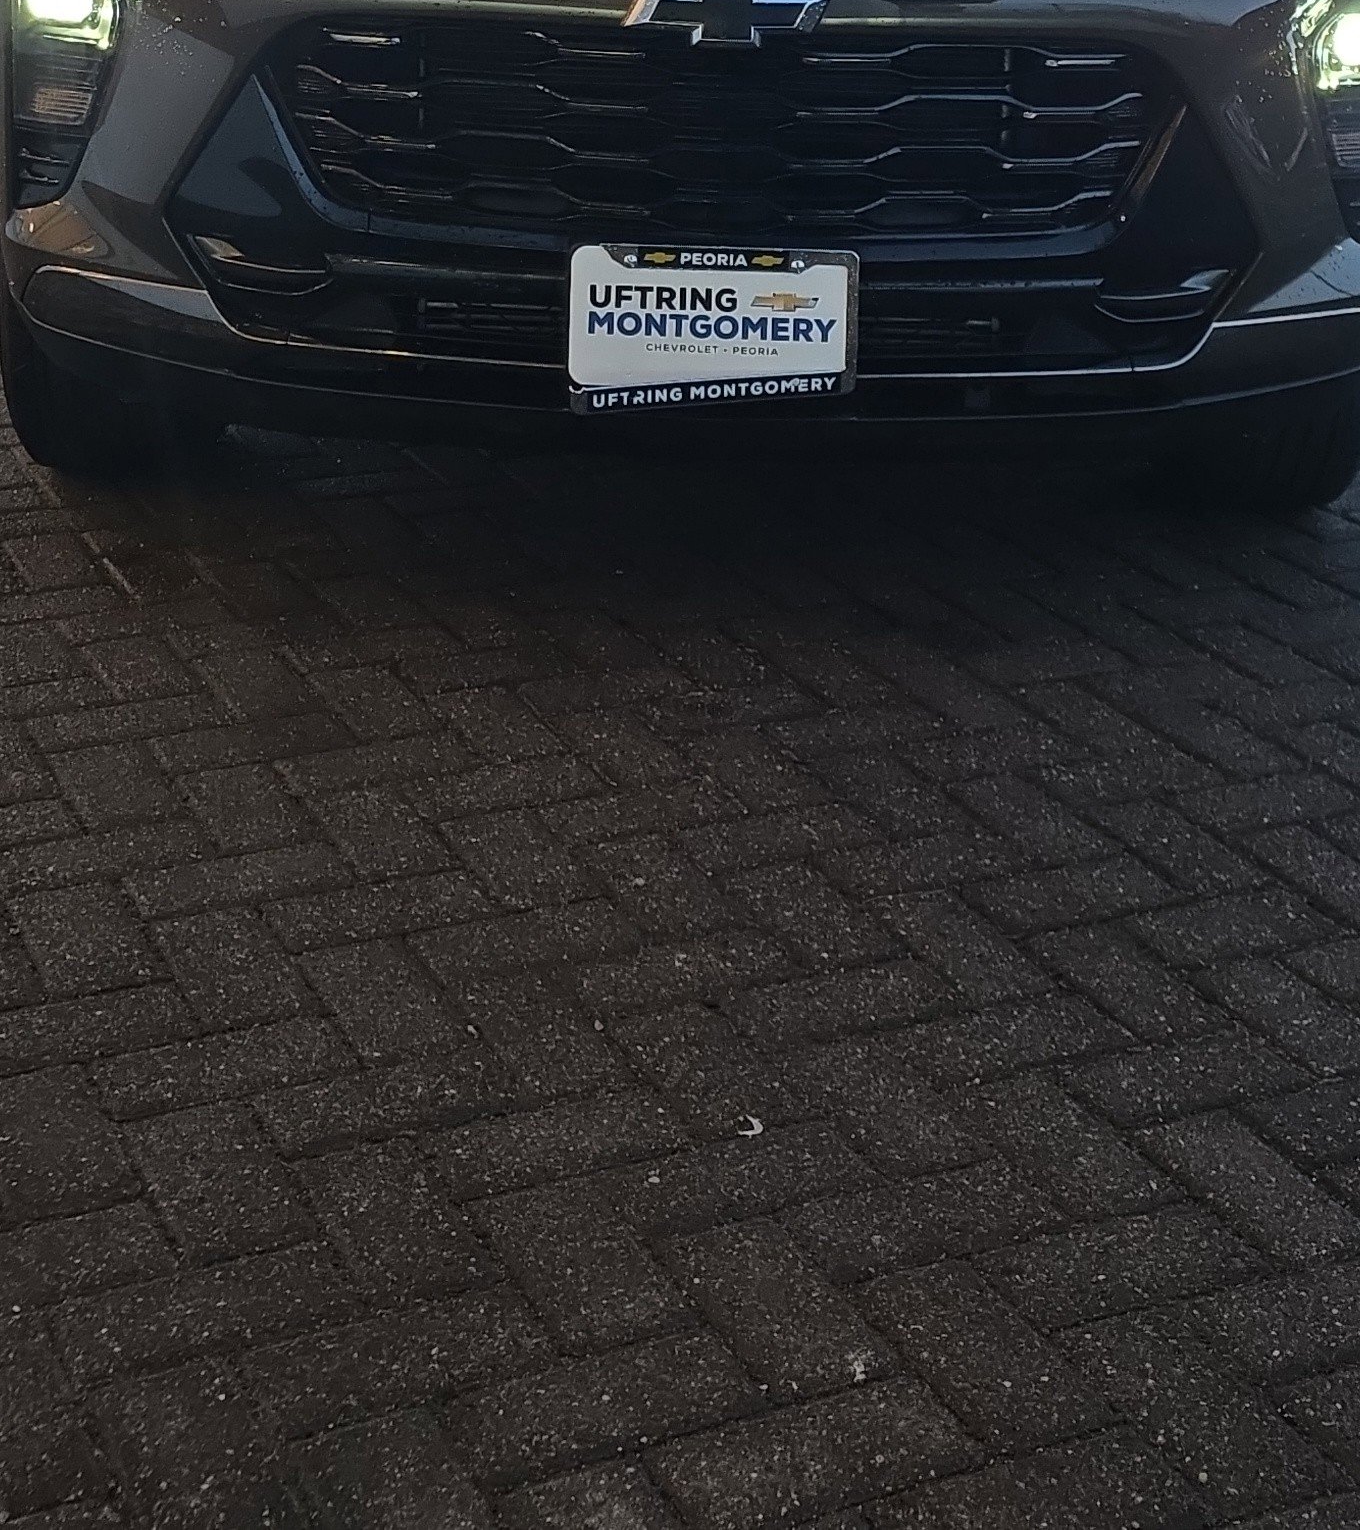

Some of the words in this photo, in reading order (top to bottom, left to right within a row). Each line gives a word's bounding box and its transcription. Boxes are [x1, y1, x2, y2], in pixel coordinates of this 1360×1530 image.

[680, 253, 748, 267] PEORIA
[589, 284, 738, 313] UFTRING
[587, 311, 838, 343] MONTGOMERY
[645, 343, 719, 354] CHEVROLET
[732, 346, 779, 356] PEORIA
[592, 387, 683, 408] UFTRING
[689, 377, 837, 400] MONTGOMERY
